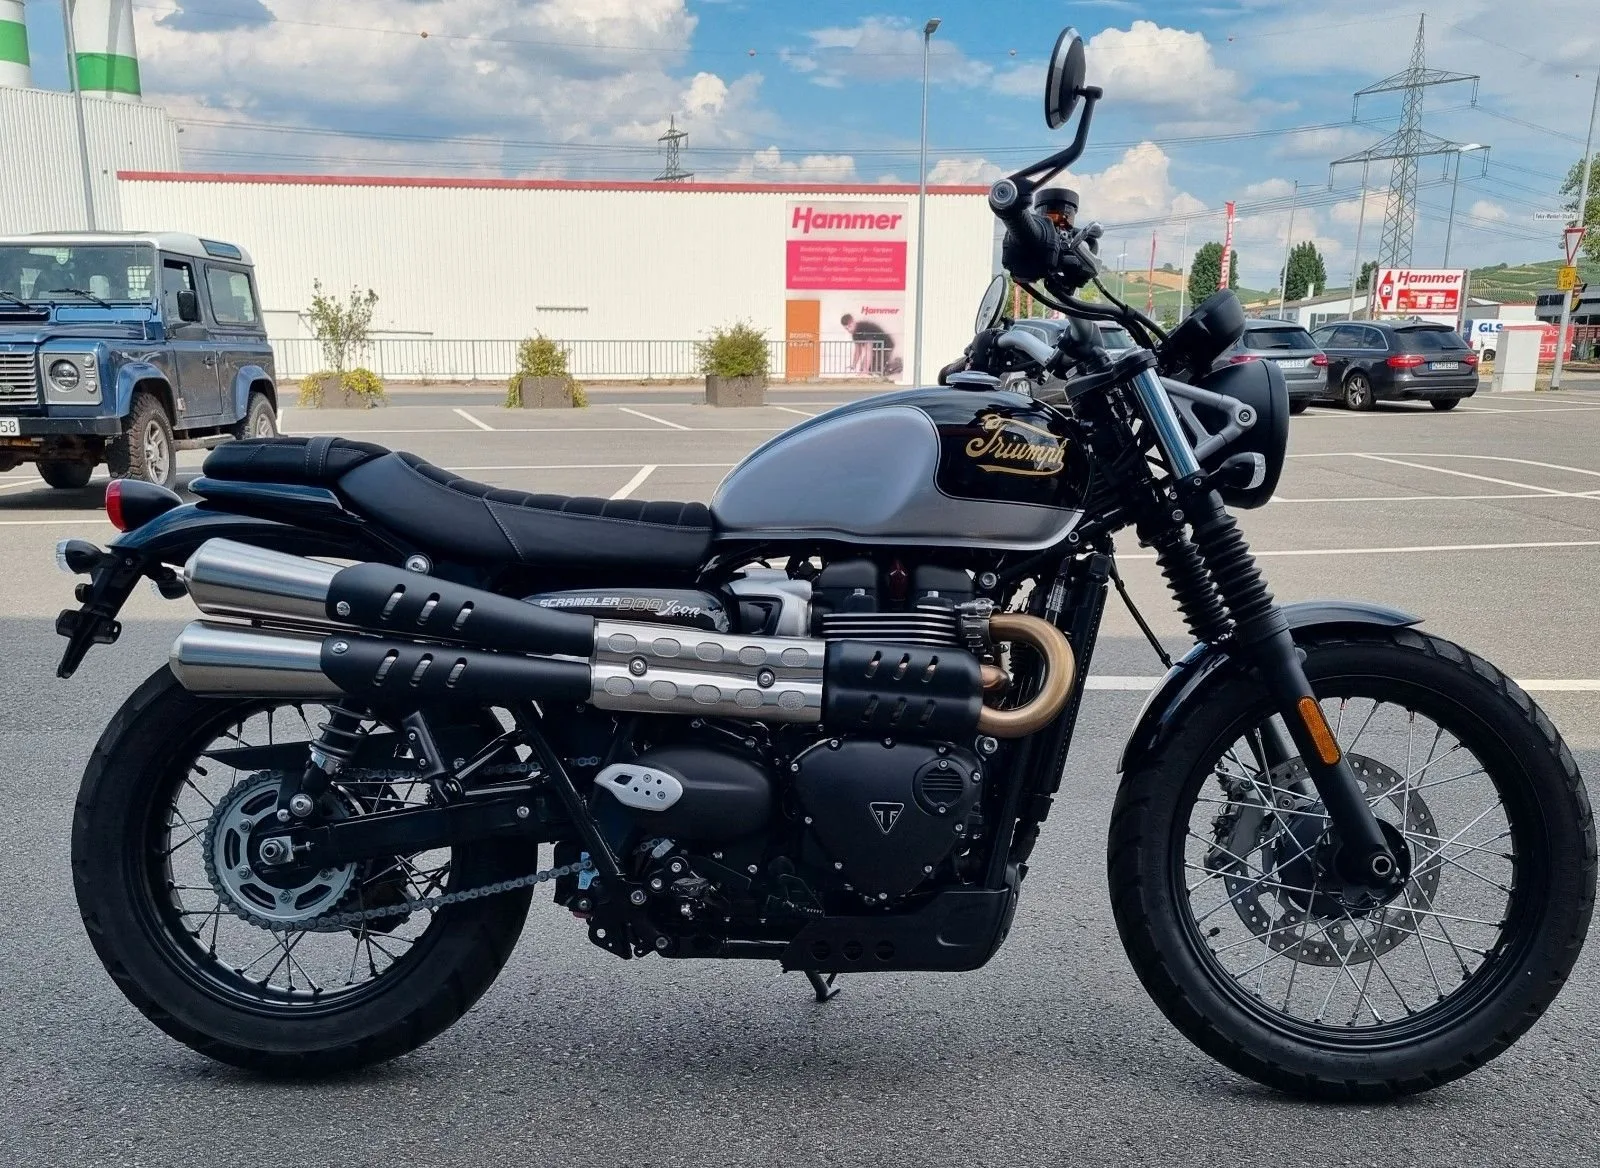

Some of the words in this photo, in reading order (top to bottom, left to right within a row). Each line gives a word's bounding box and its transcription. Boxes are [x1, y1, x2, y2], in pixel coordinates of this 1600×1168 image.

[792, 207, 902, 233] Hammer
[1398, 271, 1461, 285] Hammer
[861, 306, 900, 315] Hammer
[1478, 323, 1503, 333] GLS
[966, 413, 1071, 475] Triumph
[539, 597, 619, 608] SCRAMBLER
[617, 598, 664, 611] 900
[655, 599, 701, 616] Icon
